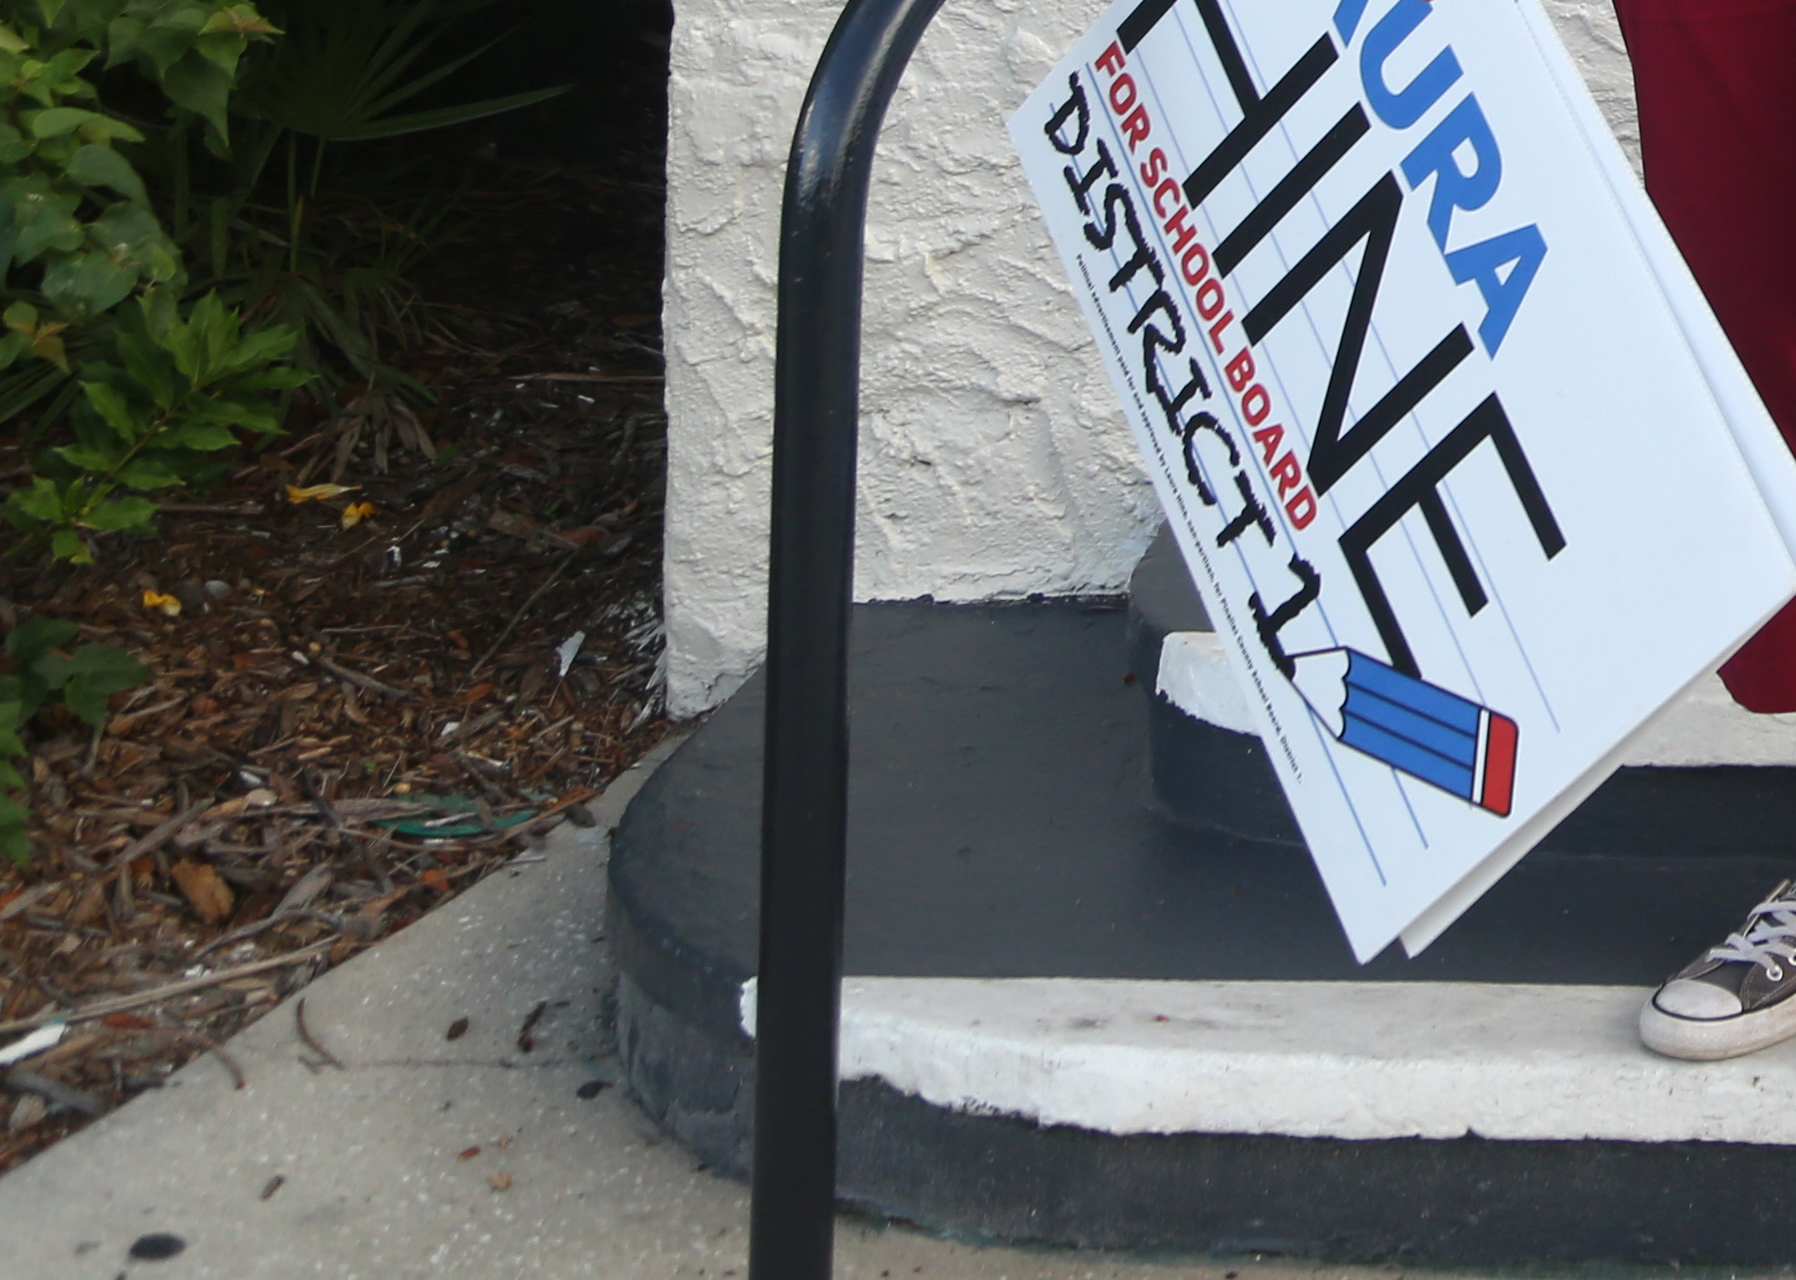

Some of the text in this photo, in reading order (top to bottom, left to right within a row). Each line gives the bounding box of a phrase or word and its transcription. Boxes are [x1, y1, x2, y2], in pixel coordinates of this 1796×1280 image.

[1043, 70, 1321, 681] DISTRICT 1
[1095, 41, 1319, 532] FOR SCHOOL BOARD
